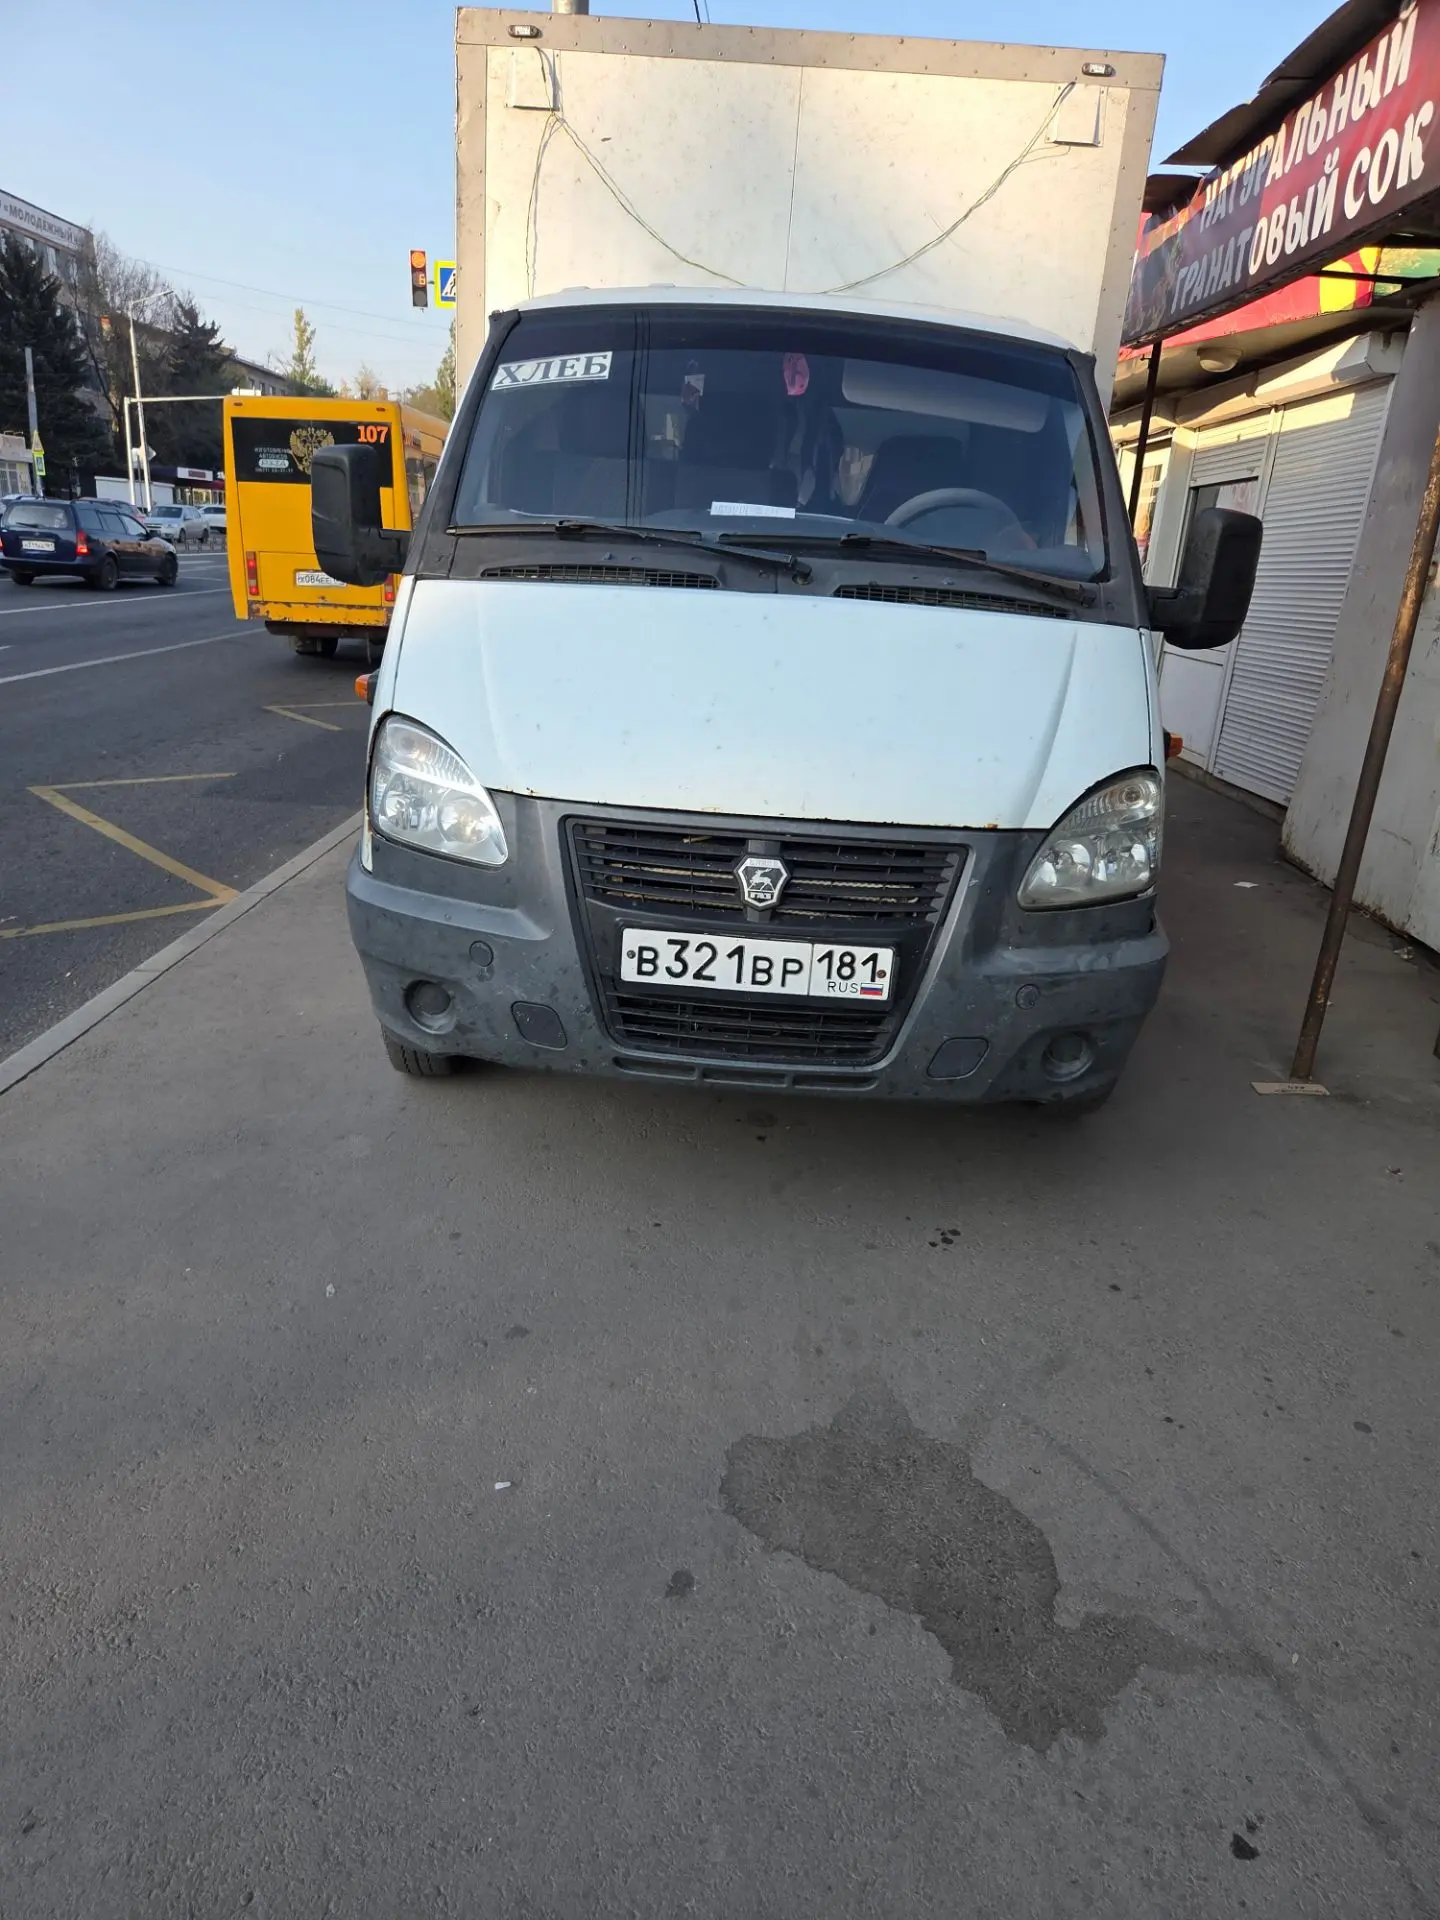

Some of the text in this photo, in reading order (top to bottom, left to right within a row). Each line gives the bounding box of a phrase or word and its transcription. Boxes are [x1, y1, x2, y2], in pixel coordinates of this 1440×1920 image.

[1200, 1, 1419, 233] НАТУРАЛЬНЫЙ
[1171, 100, 1434, 314] ГРАНАТОВЫЙ СОК
[498, 353, 608, 385] ХЛЕБ
[357, 425, 389, 444] 107
[636, 938, 880, 987] В321ВР 181
[827, 981, 859, 993] RUS
